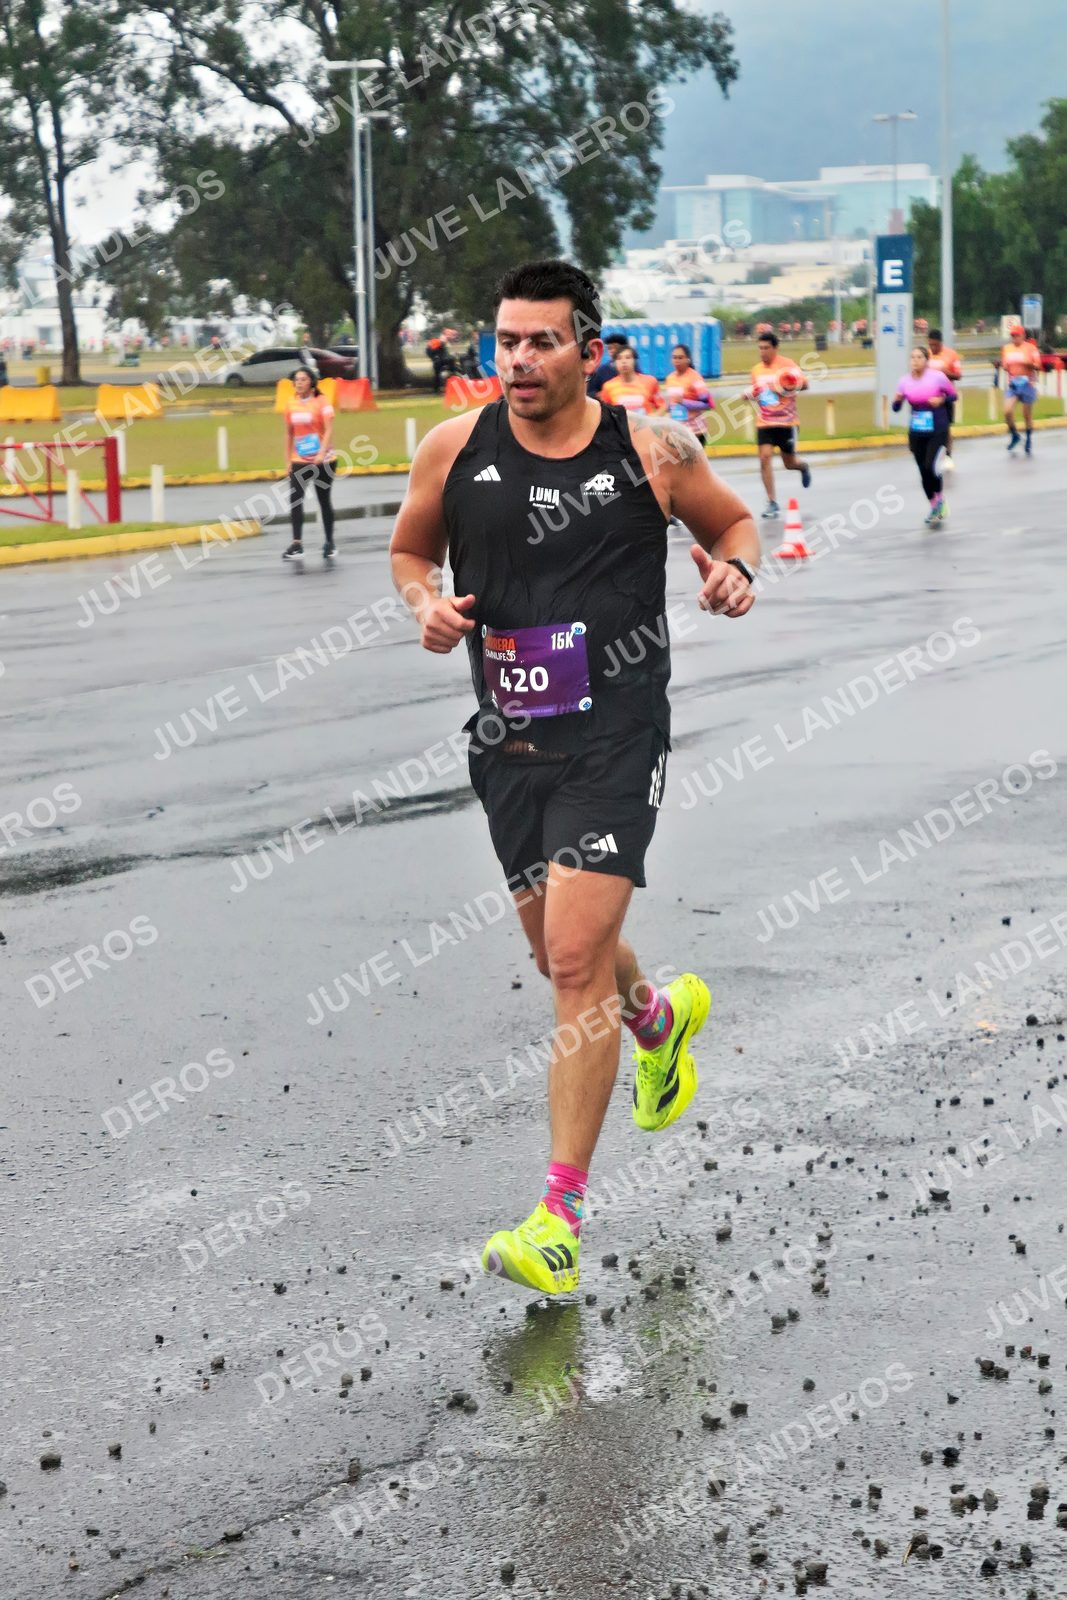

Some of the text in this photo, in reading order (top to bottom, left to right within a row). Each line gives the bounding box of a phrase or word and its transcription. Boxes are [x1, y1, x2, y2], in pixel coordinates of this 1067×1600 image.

[882, 259, 904, 287] E
[529, 485, 560, 507] LUNA
[500, 666, 549, 693] 420
